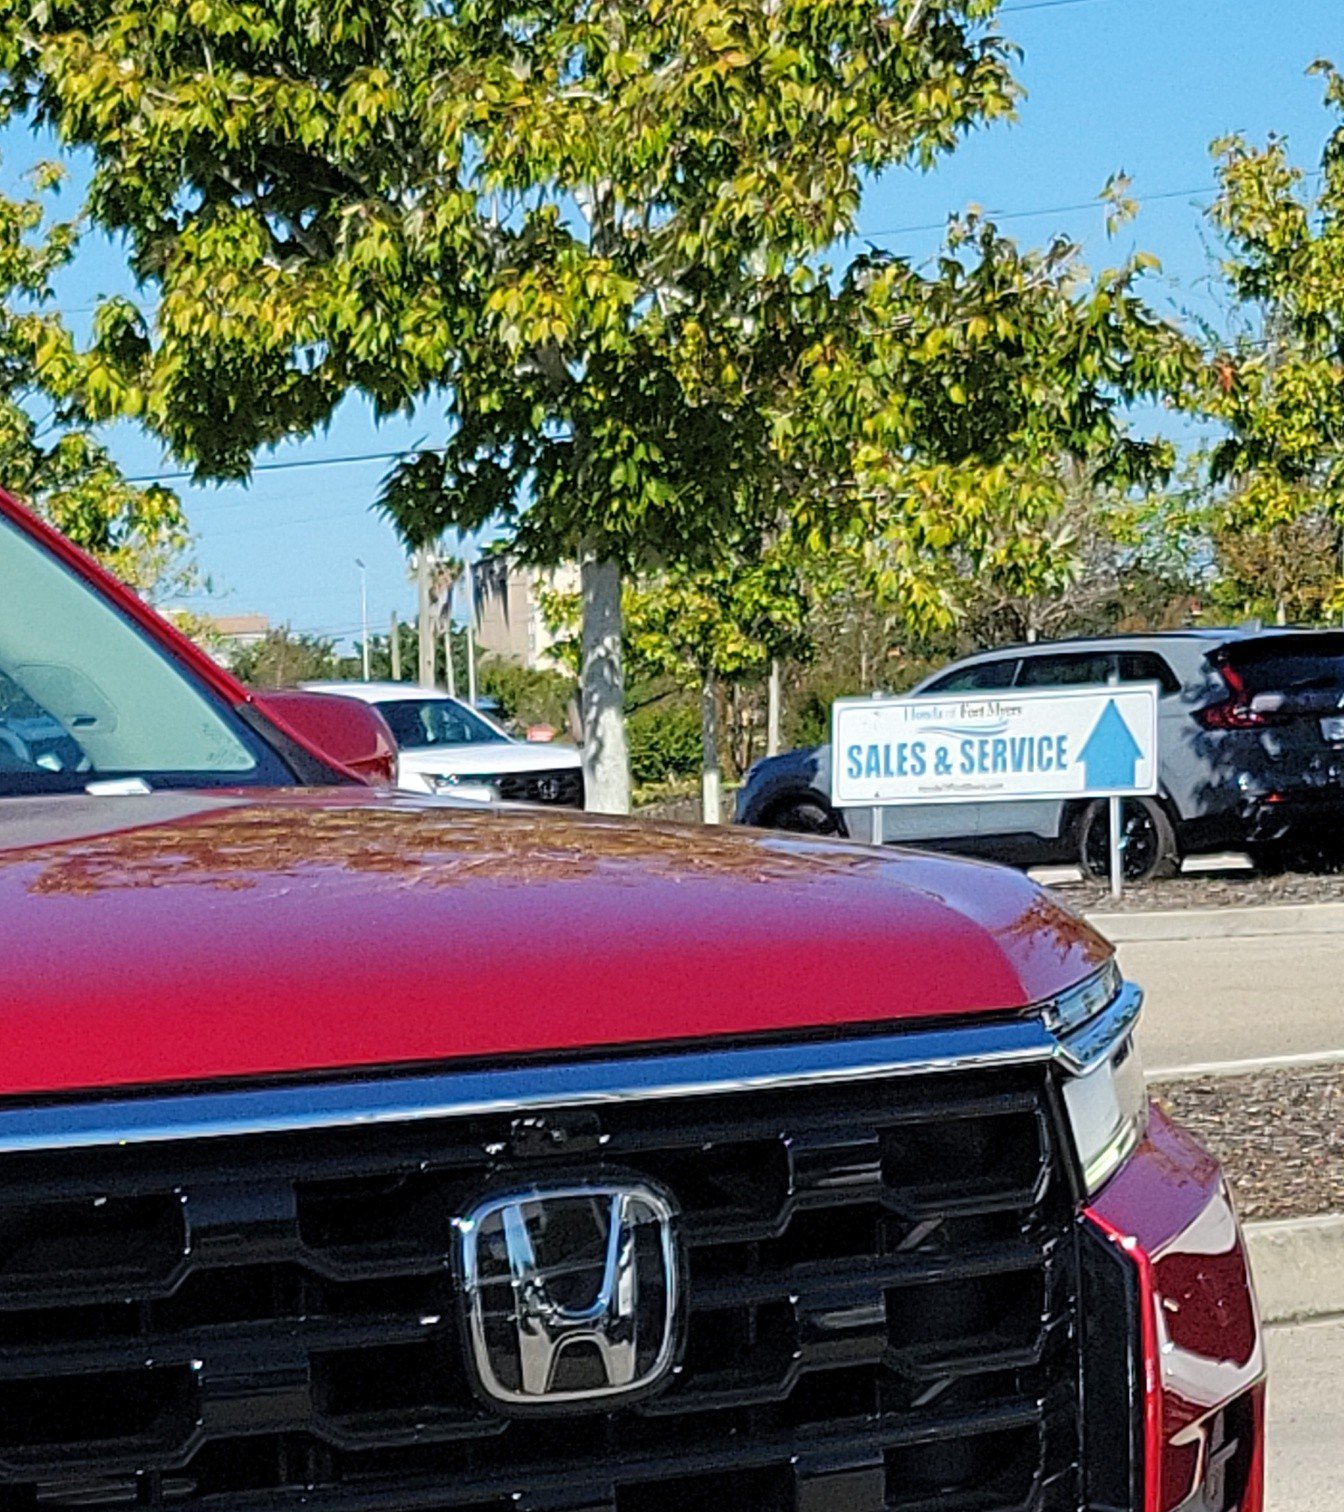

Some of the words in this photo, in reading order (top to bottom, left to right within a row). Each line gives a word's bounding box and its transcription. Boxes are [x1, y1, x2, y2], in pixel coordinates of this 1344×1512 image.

[959, 702, 985, 719] Fort
[987, 701, 1024, 721] Myers
[847, 741, 926, 779] SALES
[934, 747, 953, 775] &
[960, 735, 1068, 776] SERVICE
